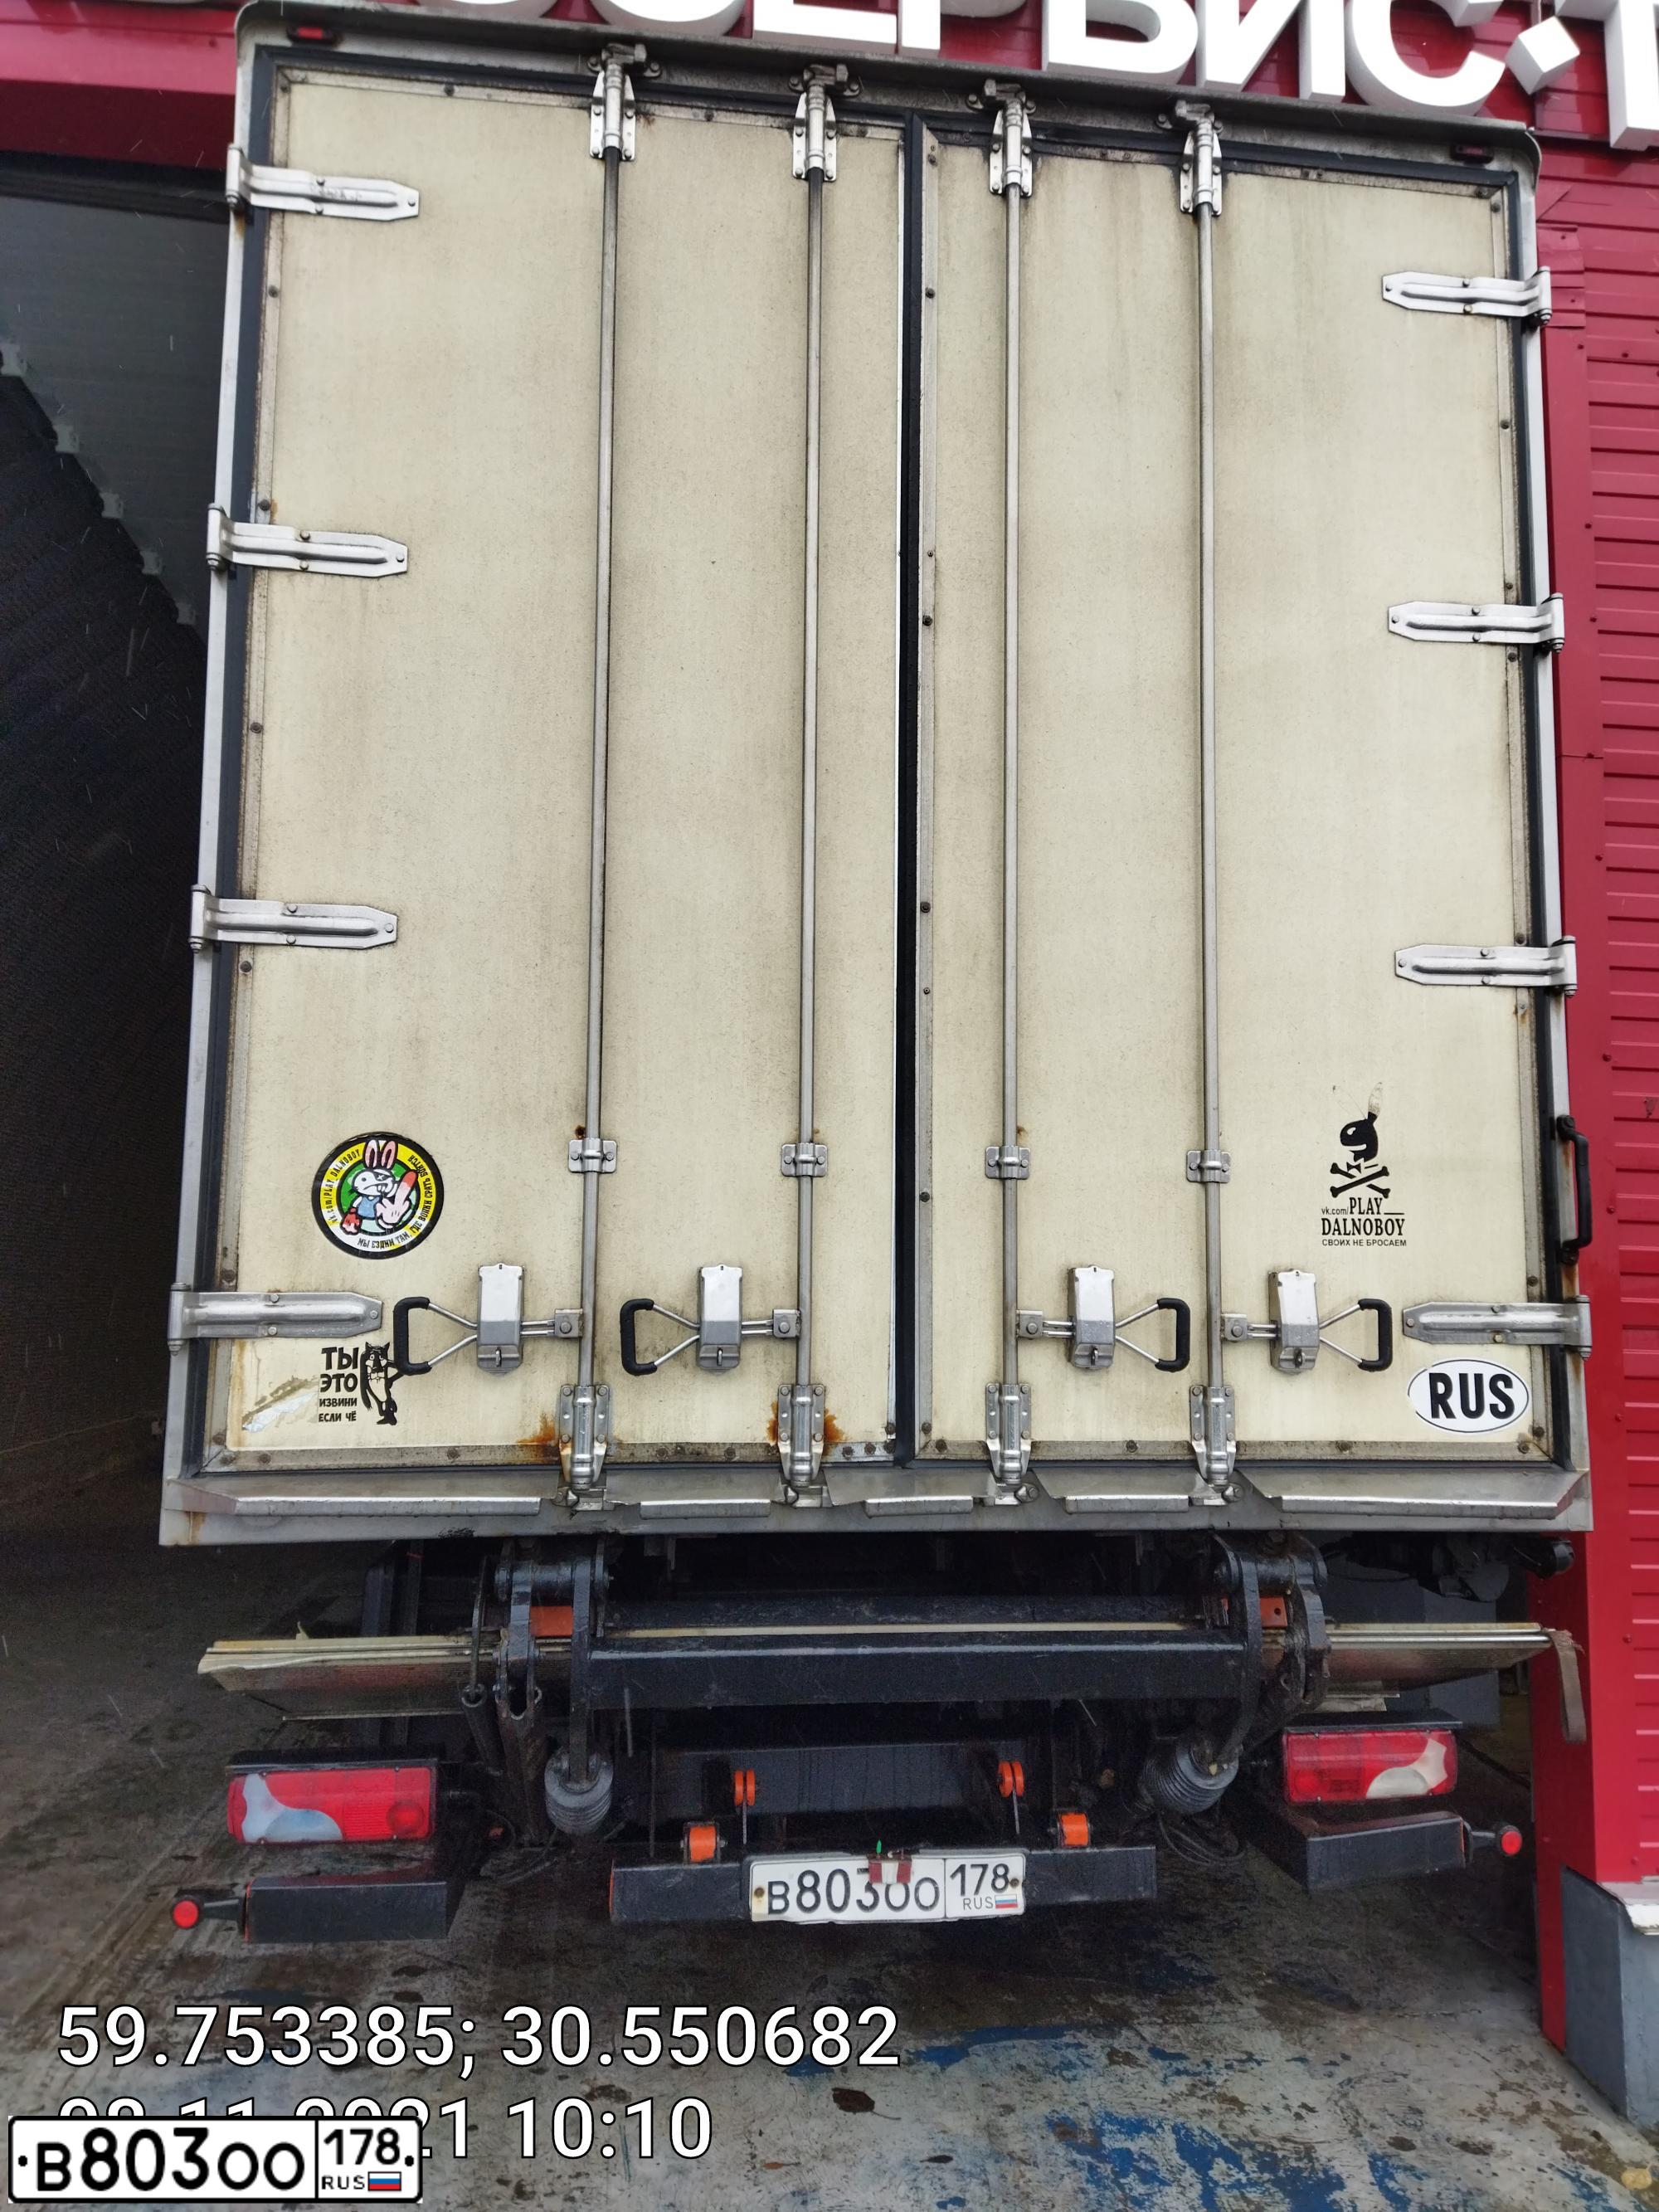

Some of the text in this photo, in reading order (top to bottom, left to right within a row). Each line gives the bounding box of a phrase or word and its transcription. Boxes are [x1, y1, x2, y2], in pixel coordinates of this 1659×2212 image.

[422, 1178, 433, 1198] СРАТЬ
[418, 1200, 432, 1221] ВОЛКИ
[410, 1220, 423, 1234] ГДЕ
[1321, 1217, 1405, 1236] DALNOBOY
[358, 1237, 370, 1248] МЫ
[371, 1239, 395, 1249] ЕЗДИМ
[321, 1347, 359, 1371] ТЫ
[320, 1373, 358, 1393] ЭТО
[319, 1397, 358, 1408] ИЗВИНИ
[1428, 1372, 1515, 1420] RUS
[319, 1411, 357, 1423] ЕСЛИ ЧЁ
[949, 1864, 1010, 1897] 178
[963, 1897, 994, 1911] RUS
